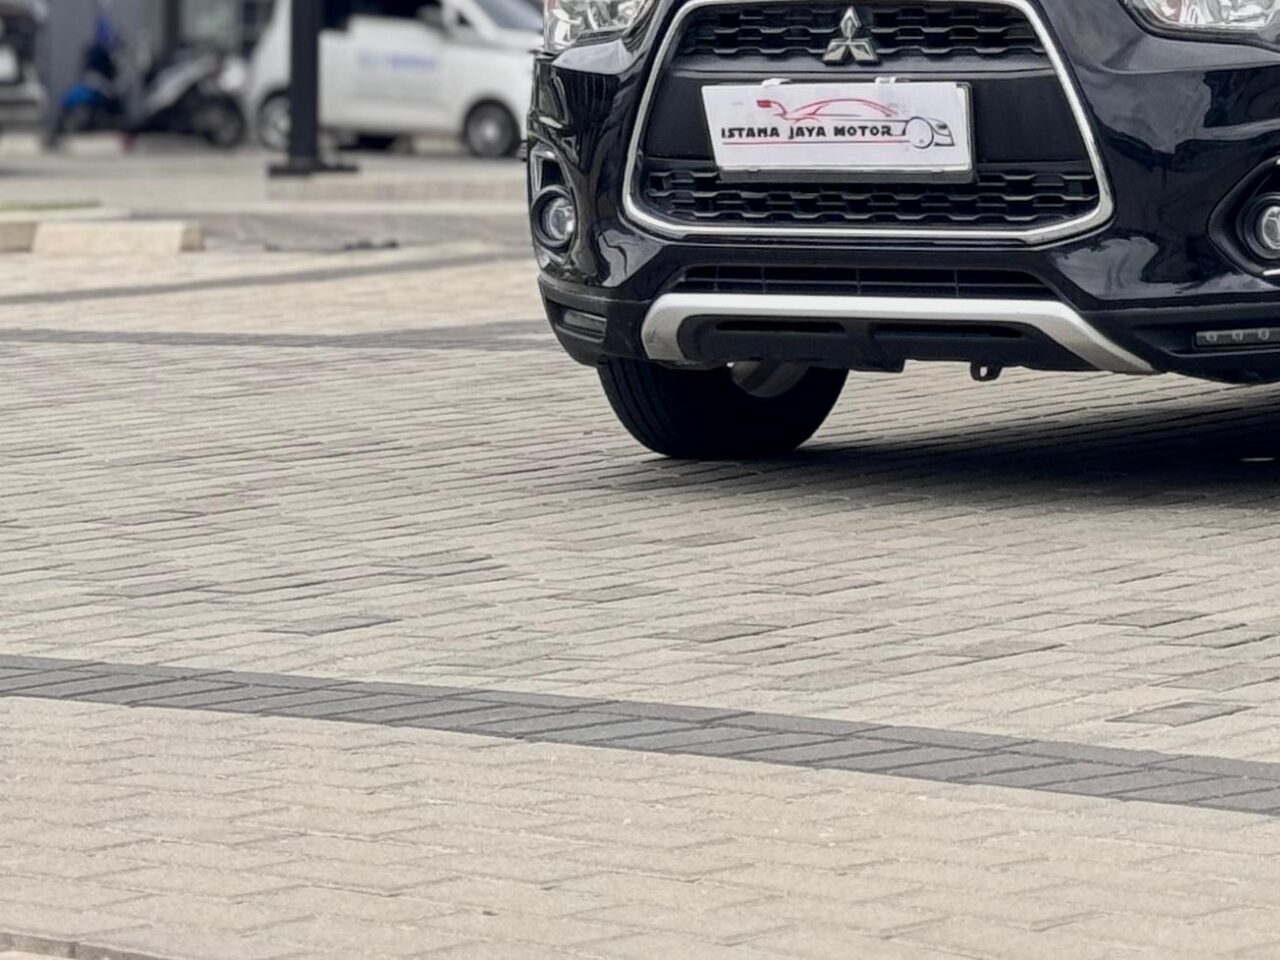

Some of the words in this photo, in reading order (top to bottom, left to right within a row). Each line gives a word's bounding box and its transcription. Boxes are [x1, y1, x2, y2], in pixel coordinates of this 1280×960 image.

[721, 125, 781, 139] ISTANA
[787, 125, 826, 140] JAYA
[833, 124, 894, 138] MOTOR
